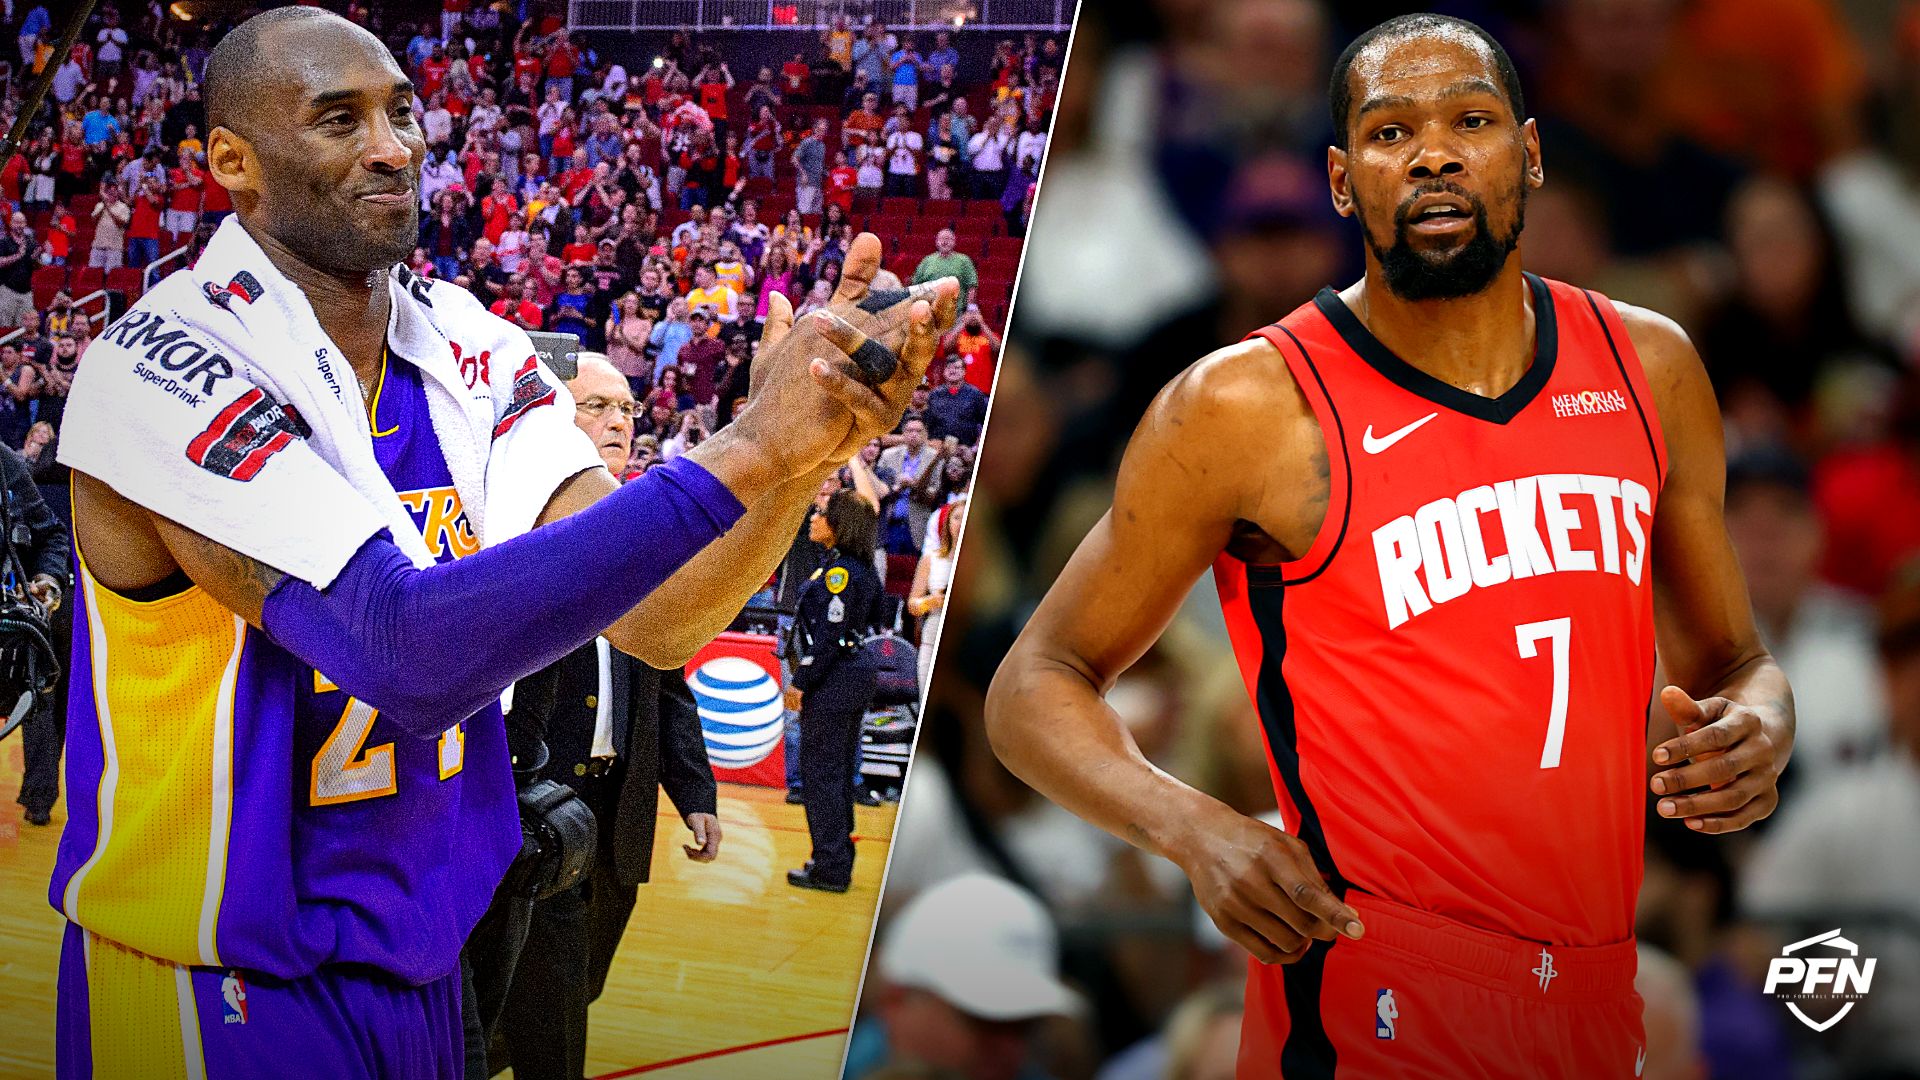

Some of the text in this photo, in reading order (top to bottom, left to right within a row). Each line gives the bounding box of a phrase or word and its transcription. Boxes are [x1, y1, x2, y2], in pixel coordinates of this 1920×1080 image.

[102, 309, 234, 397] RMOR
[132, 361, 203, 408] SuperDrink
[1551, 389, 1625, 407] MEMORIAL
[1553, 398, 1627, 418] HERMANN
[1371, 473, 1652, 631] ROCKETS
[1514, 616, 1571, 769] 7
[309, 668, 465, 807] 2
[224, 1013, 241, 1024] NBA
